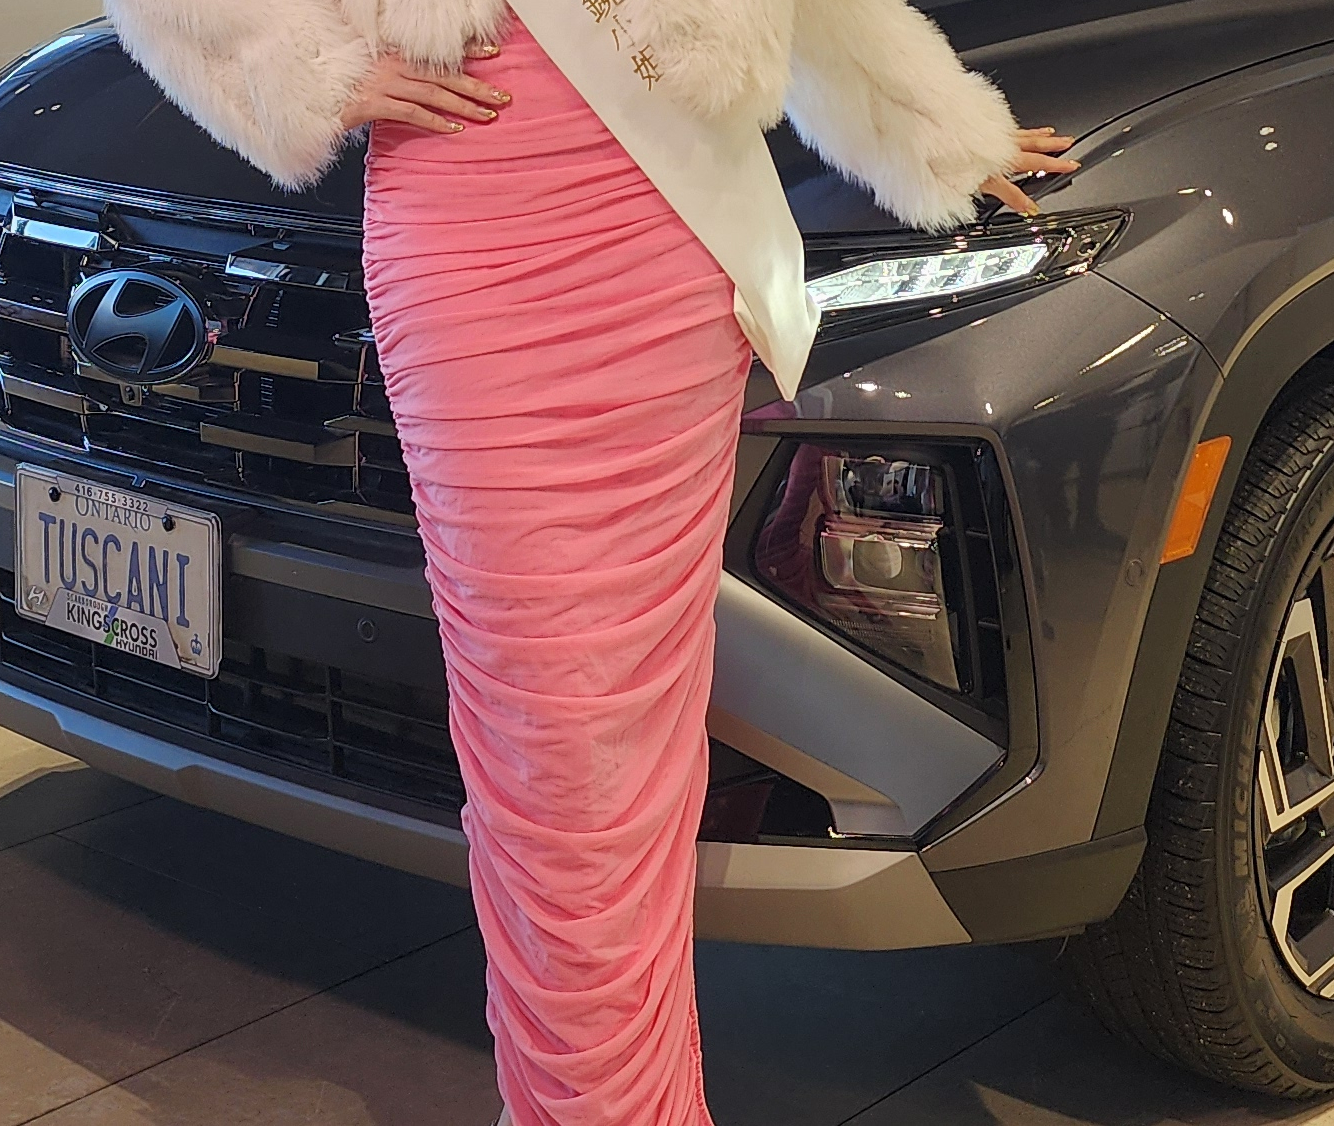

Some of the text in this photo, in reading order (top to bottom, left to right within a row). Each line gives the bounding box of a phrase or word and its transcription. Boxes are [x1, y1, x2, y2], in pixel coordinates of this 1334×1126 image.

[75, 495, 152, 532] ONTARIO
[38, 512, 190, 629] TUSCANI
[67, 602, 158, 649] KINGSCROSS
[116, 638, 158, 661] HYUNDAI
